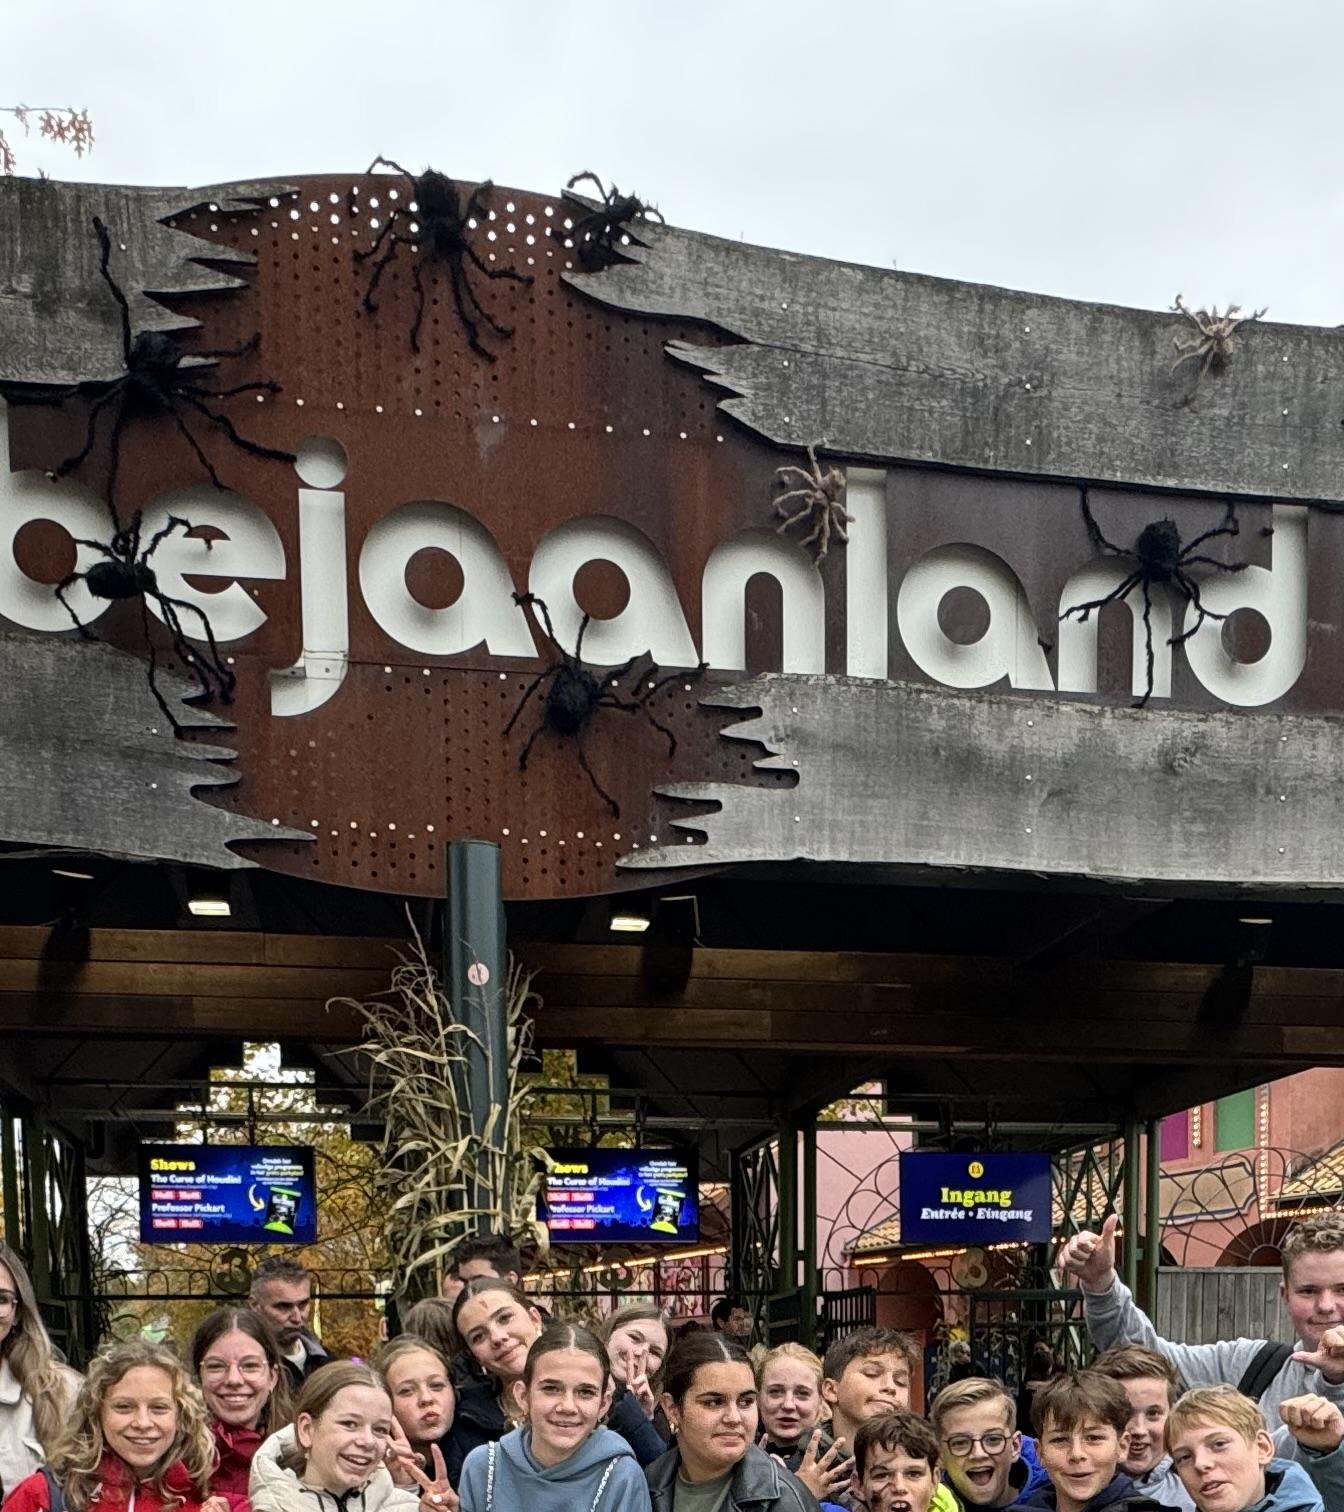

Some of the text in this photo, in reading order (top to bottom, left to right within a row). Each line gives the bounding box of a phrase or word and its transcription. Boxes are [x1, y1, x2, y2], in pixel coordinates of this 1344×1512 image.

[150, 1159, 196, 1171] Shows
[554, 1163, 589, 1174] hows
[150, 1173, 242, 1184] The Curse of Houdini
[547, 1176, 631, 1186] The Curse of Houdini
[940, 1187, 1012, 1207] Ingang
[152, 1203, 226, 1213] Professor Pickart
[586, 1204, 615, 1214] Pickart
[920, 1207, 1033, 1222] Entrée Eingang
